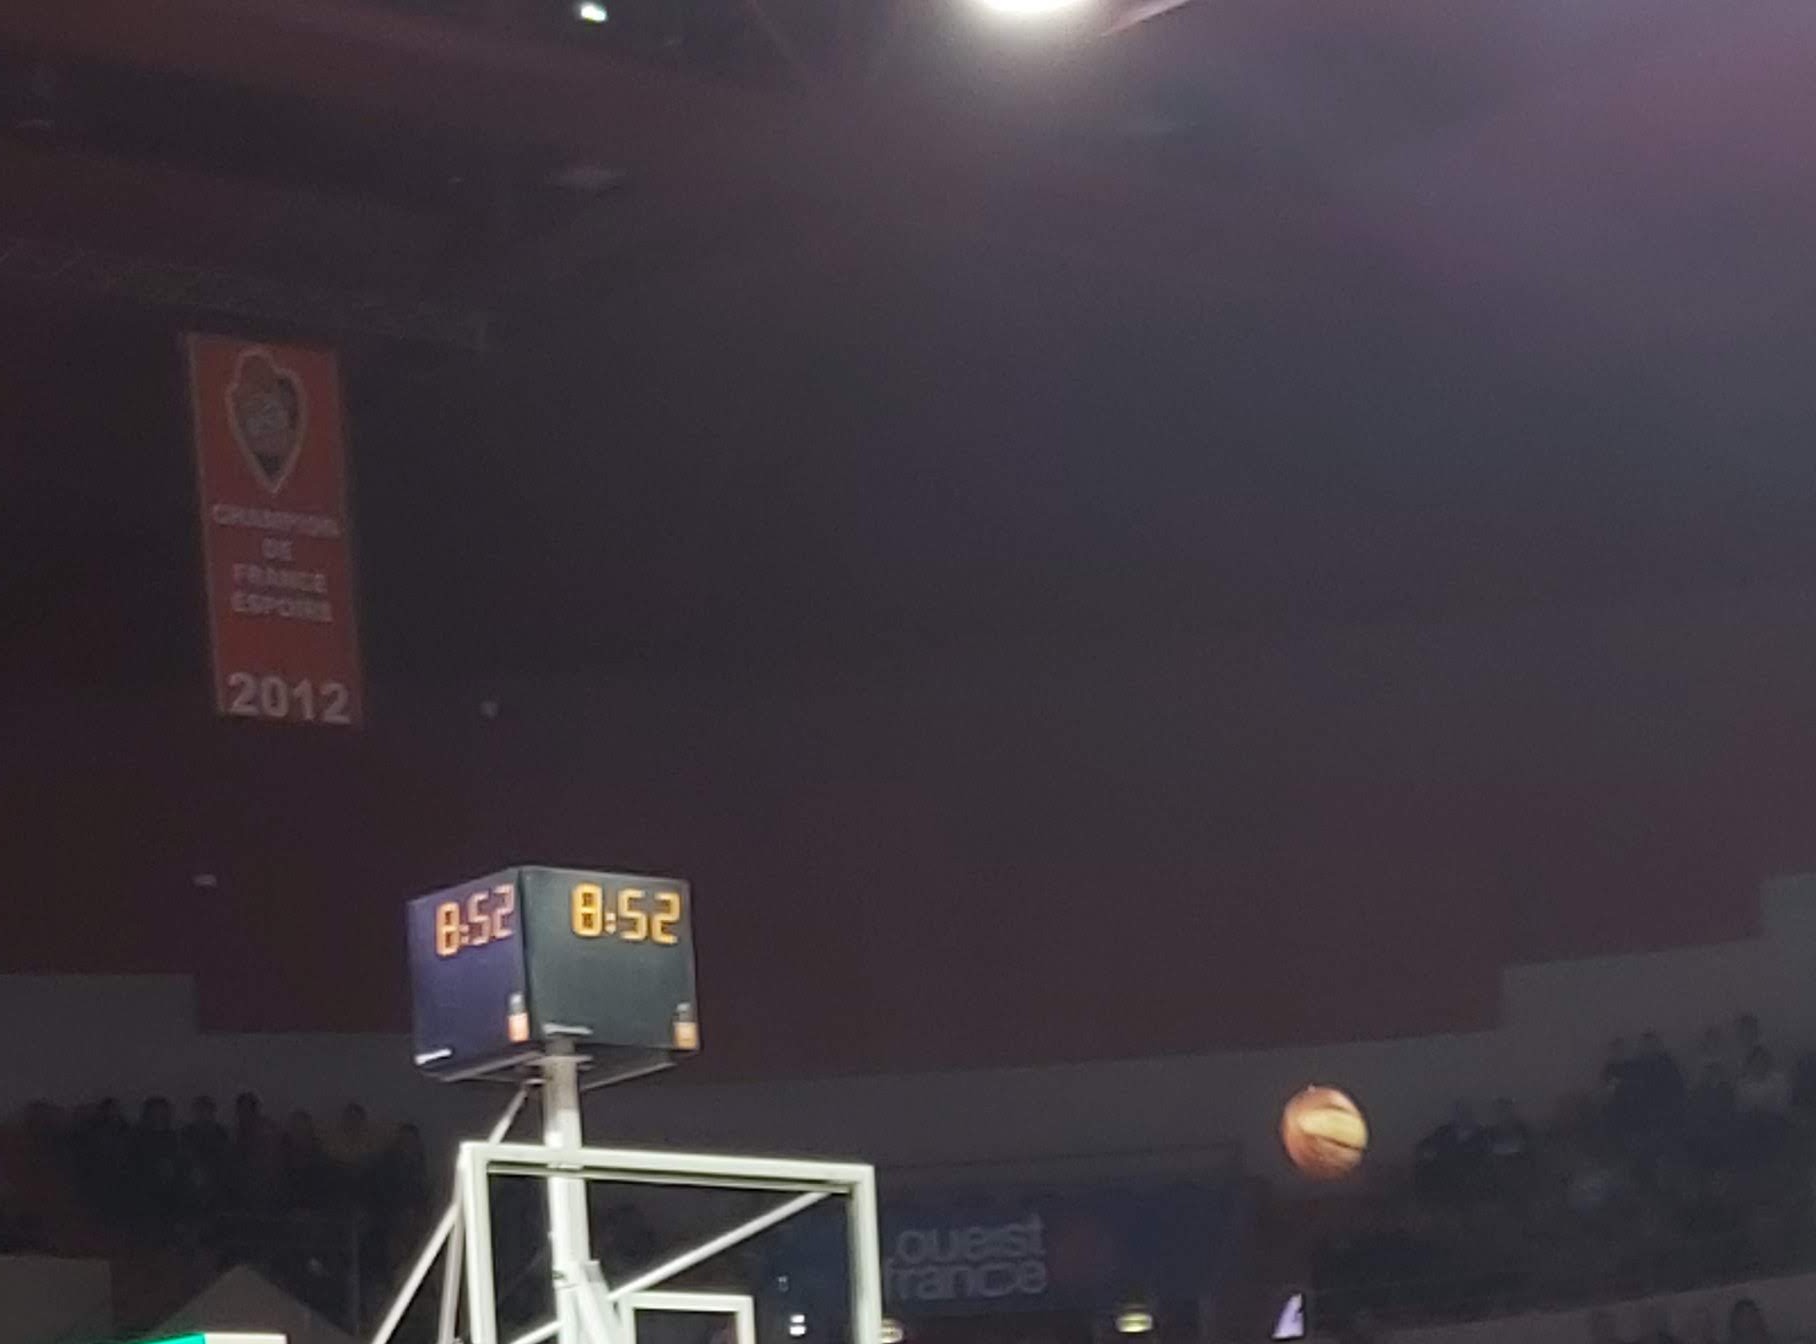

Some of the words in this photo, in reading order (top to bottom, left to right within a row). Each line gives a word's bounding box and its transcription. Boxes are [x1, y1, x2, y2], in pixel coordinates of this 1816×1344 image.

[226, 671, 352, 726] 2012
[435, 883, 516, 957] 8:52
[571, 882, 682, 945] 8:52
